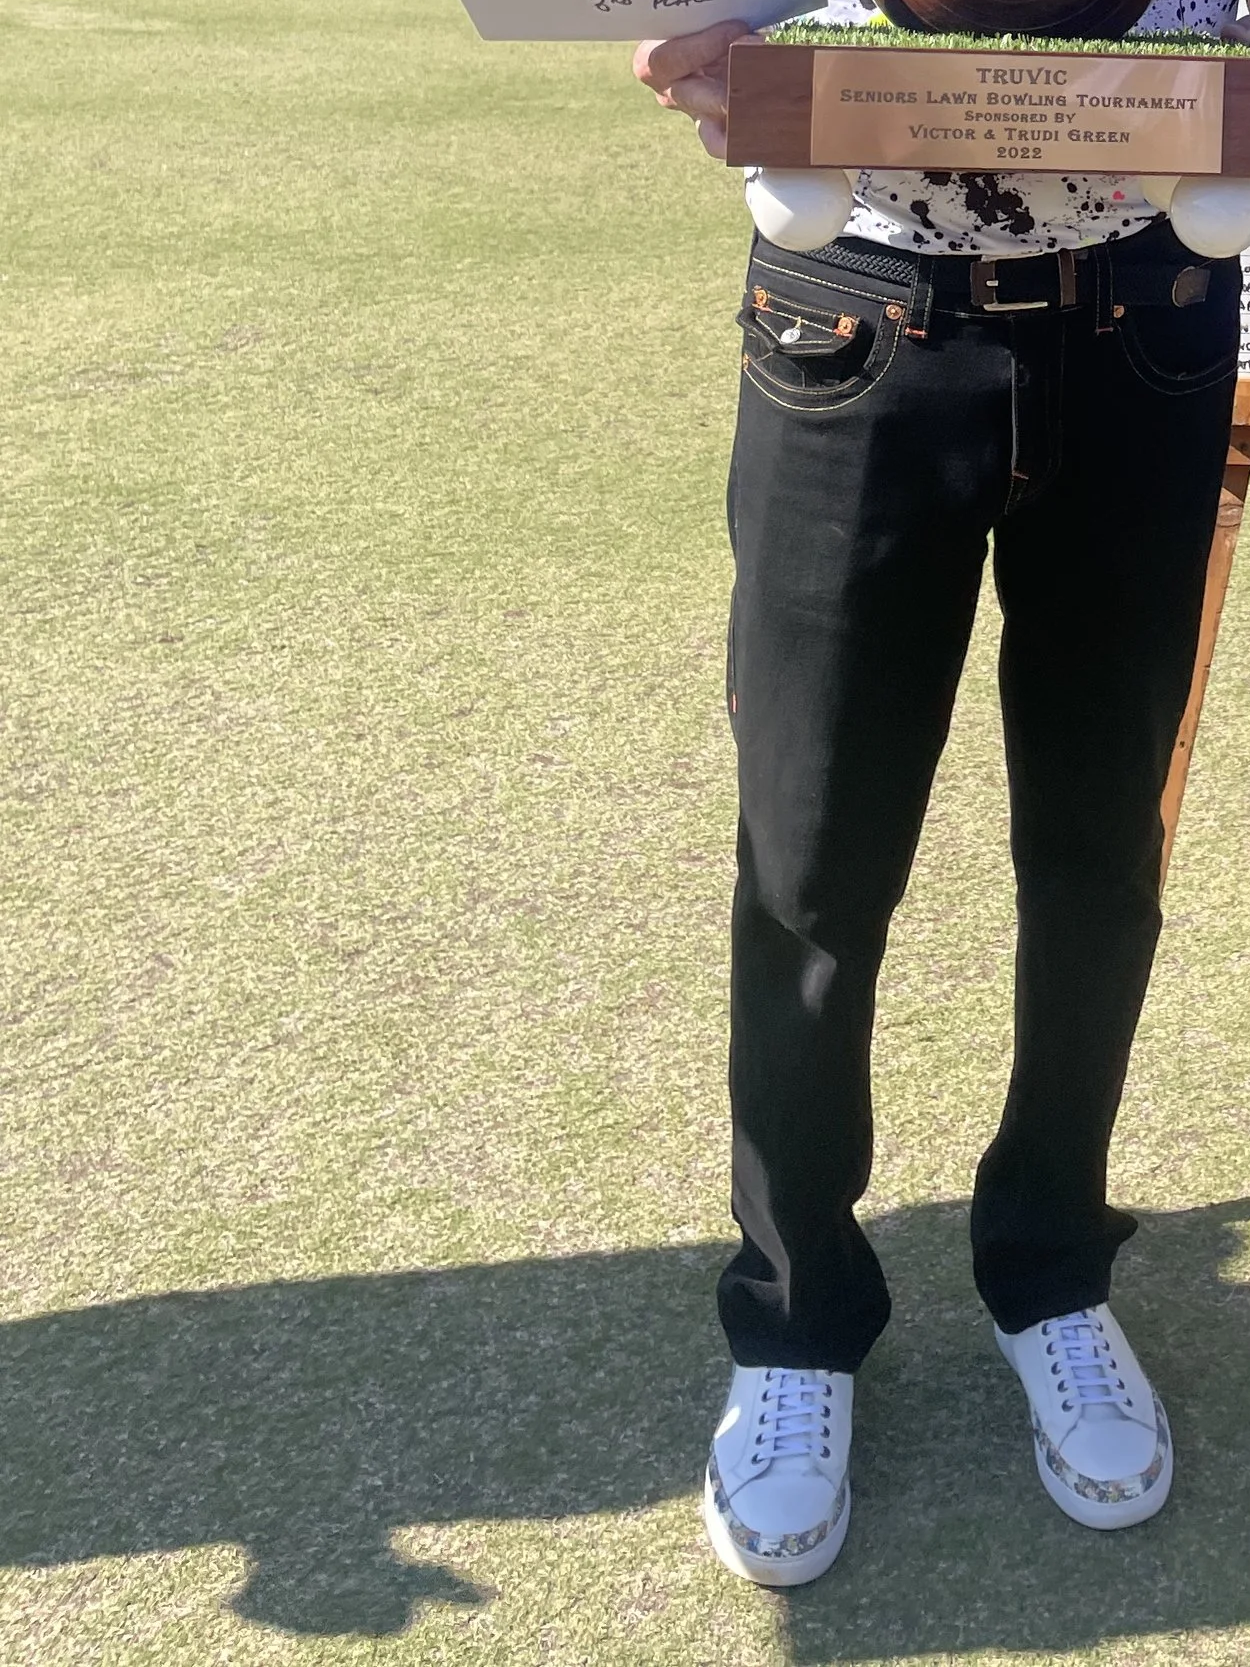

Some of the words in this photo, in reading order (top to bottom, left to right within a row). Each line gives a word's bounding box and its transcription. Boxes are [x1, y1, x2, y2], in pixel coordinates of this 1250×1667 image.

[975, 67, 1068, 86] TRUVIC
[839, 88, 918, 105] SENIORS
[926, 90, 978, 106] LAWN
[986, 92, 1067, 107] BOWLING
[1076, 94, 1198, 110] TOURNAMENT
[964, 110, 1048, 123] SPONSORED
[1054, 112, 1077, 124] BY
[908, 123, 977, 140] VICTOR
[983, 128, 996, 140] &
[1003, 127, 1060, 142] TRUDI
[1067, 128, 1131, 144] GREEN
[996, 146, 1043, 160] 2022
